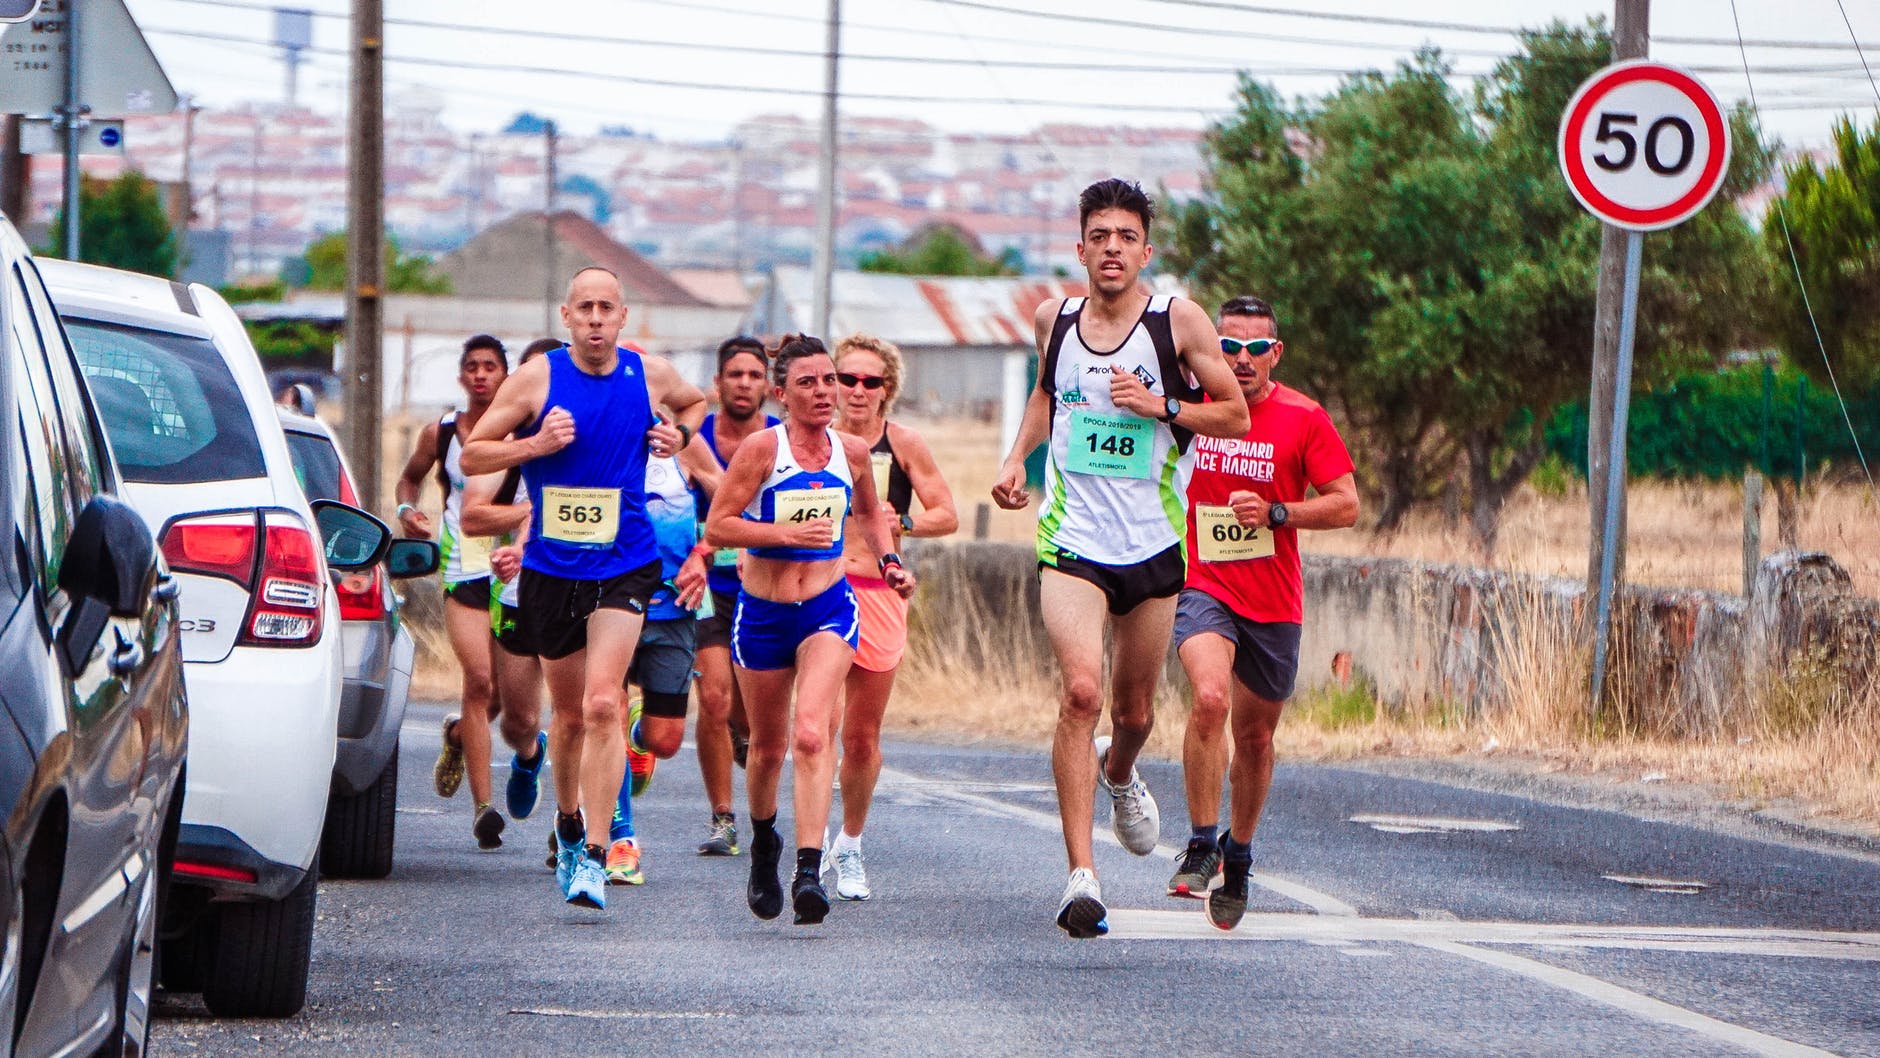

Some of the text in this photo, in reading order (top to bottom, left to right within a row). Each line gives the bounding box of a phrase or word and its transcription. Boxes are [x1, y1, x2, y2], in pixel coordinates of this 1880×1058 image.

[1593, 113, 1695, 176] 50
[1108, 421, 1142, 430] 2018/2019
[1086, 432, 1135, 456] 148
[1241, 440, 1275, 460] HARD
[1088, 462, 1127, 470] ATLETISMOITA
[1195, 451, 1275, 480] ACE HARDER
[558, 505, 602, 523] 563
[789, 507, 832, 523] 464
[1212, 524, 1258, 542] 602
[180, 618, 216, 632] C3
